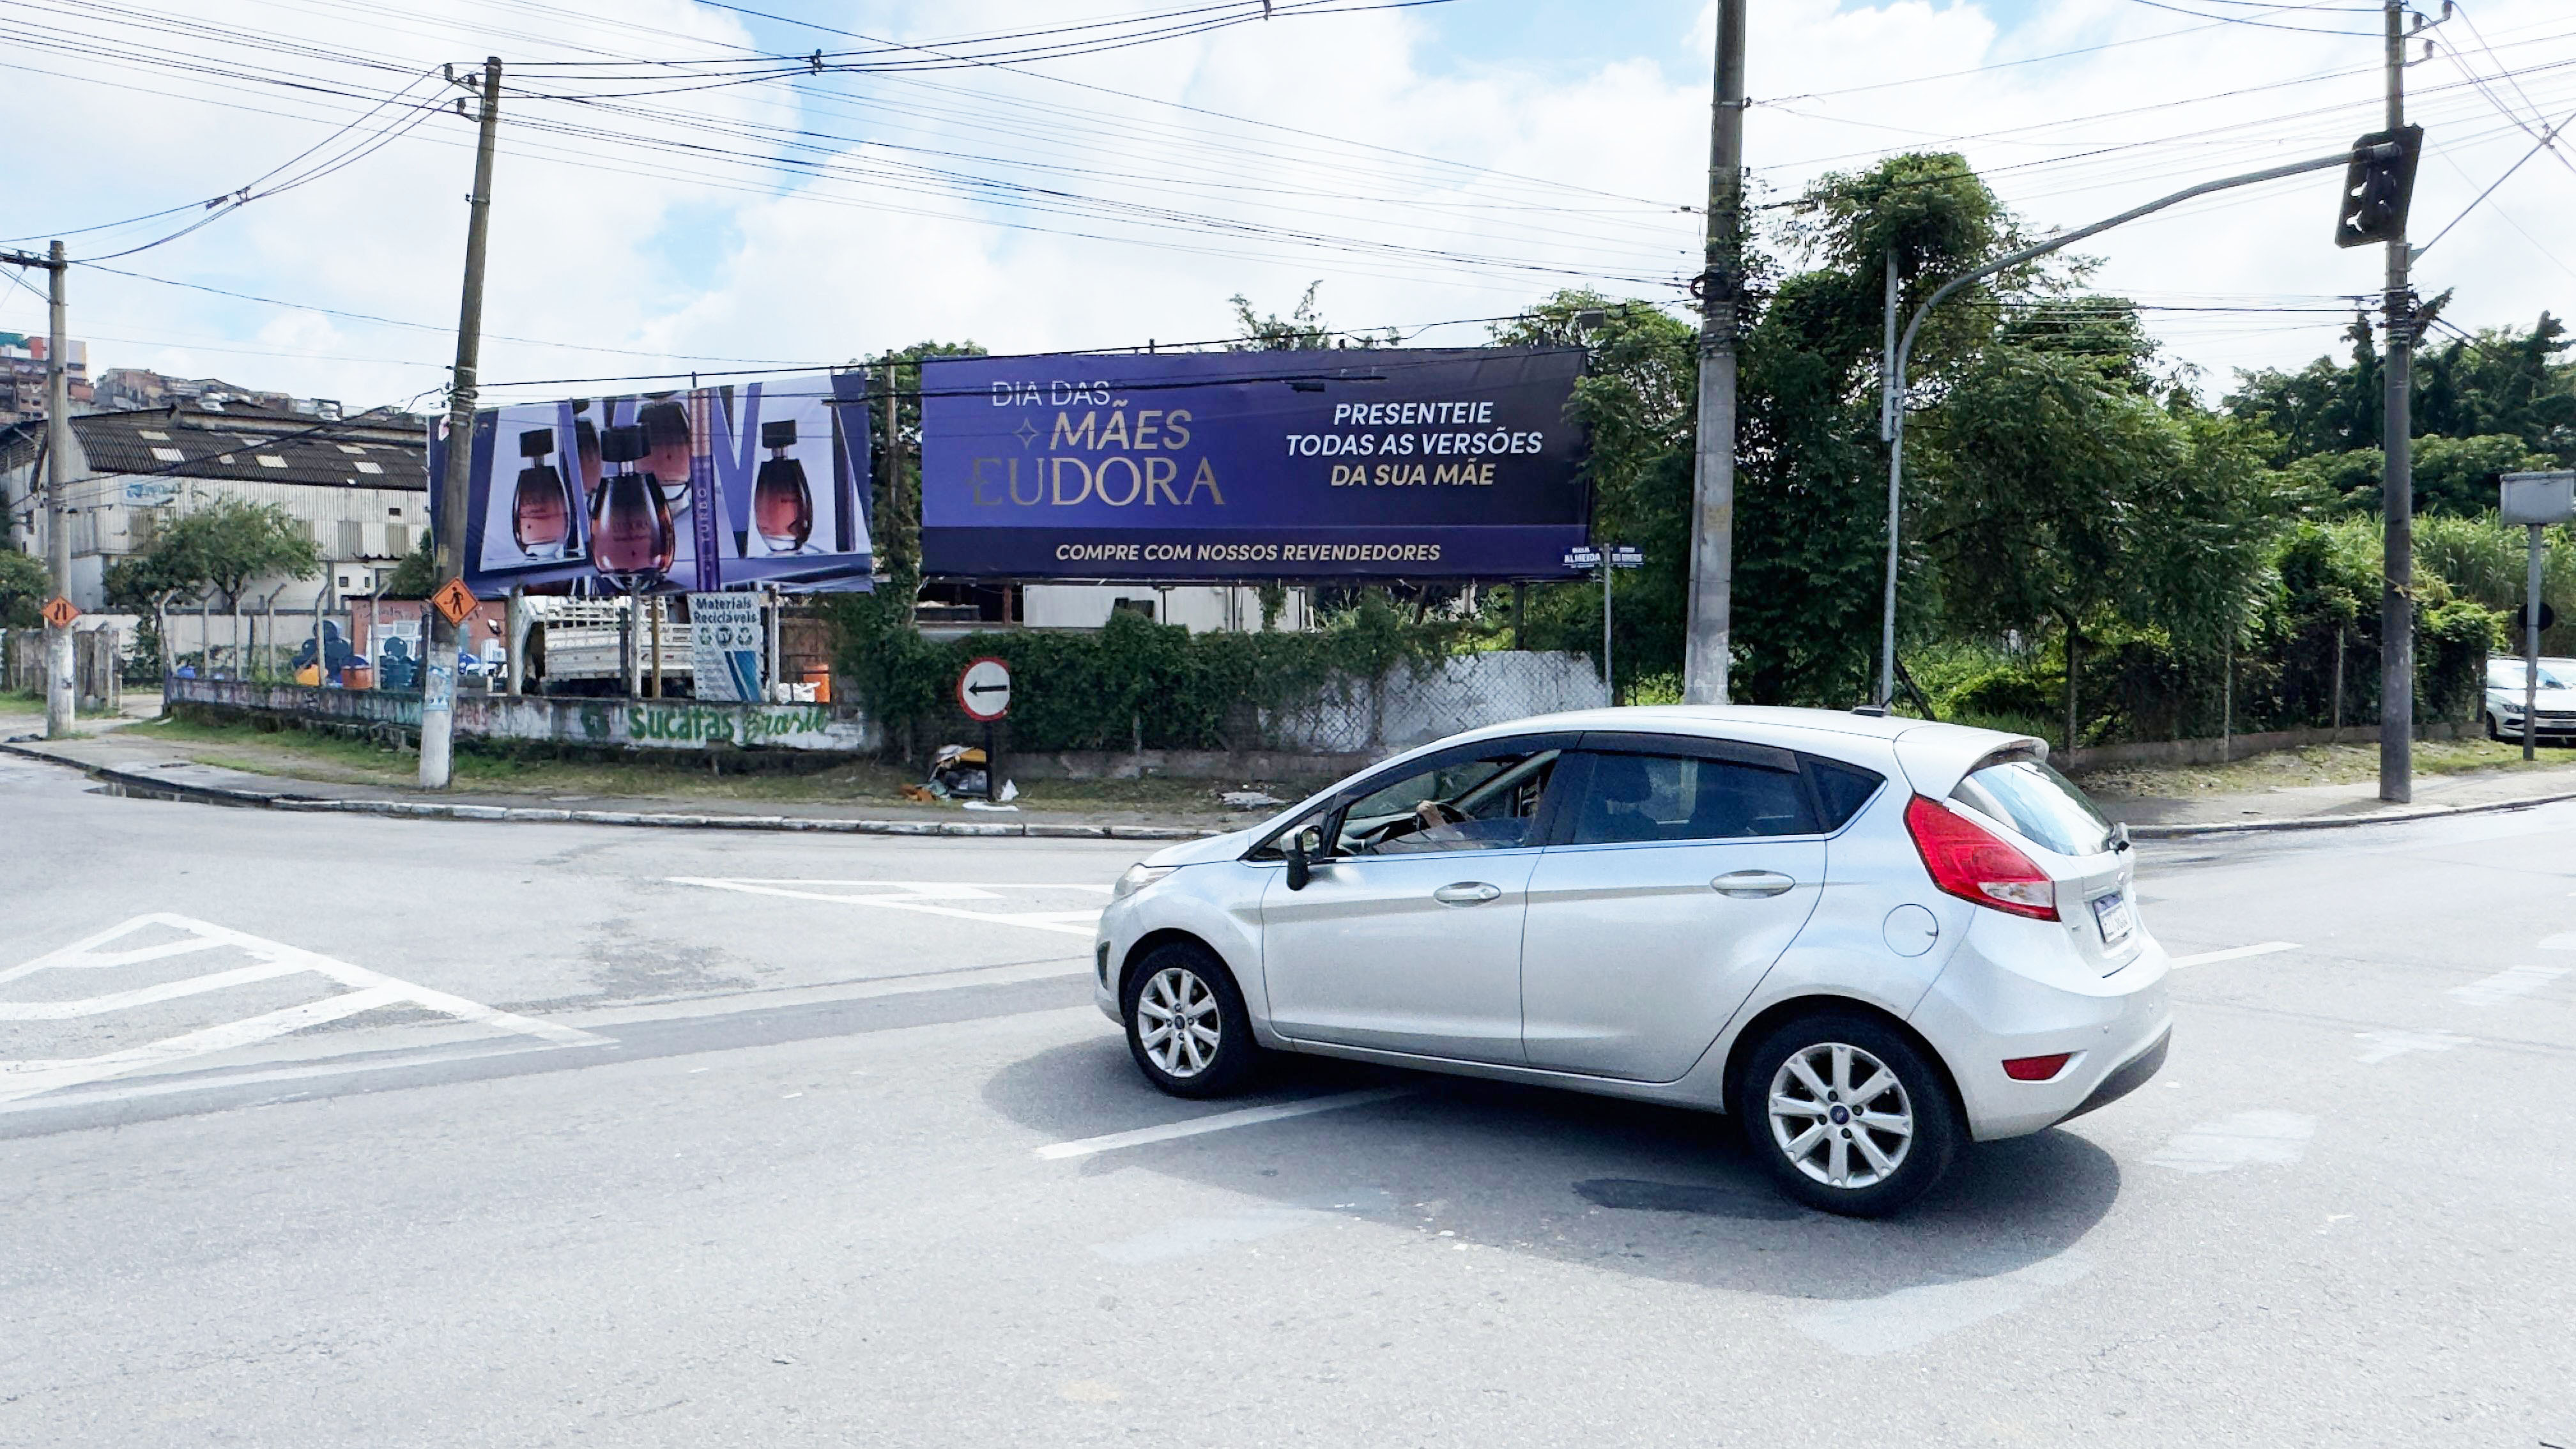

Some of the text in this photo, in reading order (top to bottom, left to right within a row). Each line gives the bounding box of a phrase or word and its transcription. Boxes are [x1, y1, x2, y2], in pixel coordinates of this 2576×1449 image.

[992, 380, 1110, 406] DIA DAS
[1048, 398, 1193, 450] MÃES
[1333, 401, 1494, 425] PRESENTEIE
[1285, 426, 1544, 456] TODAS AS VERSÕES
[966, 456, 1227, 506] EUDORA
[1330, 457, 1496, 486] DA SUA MÃE
[1055, 544, 1441, 561] COMPRE COM NOSSOS REVENDEDORES
[696, 596, 752, 610] Materiais
[627, 706, 735, 741] Sucatas
